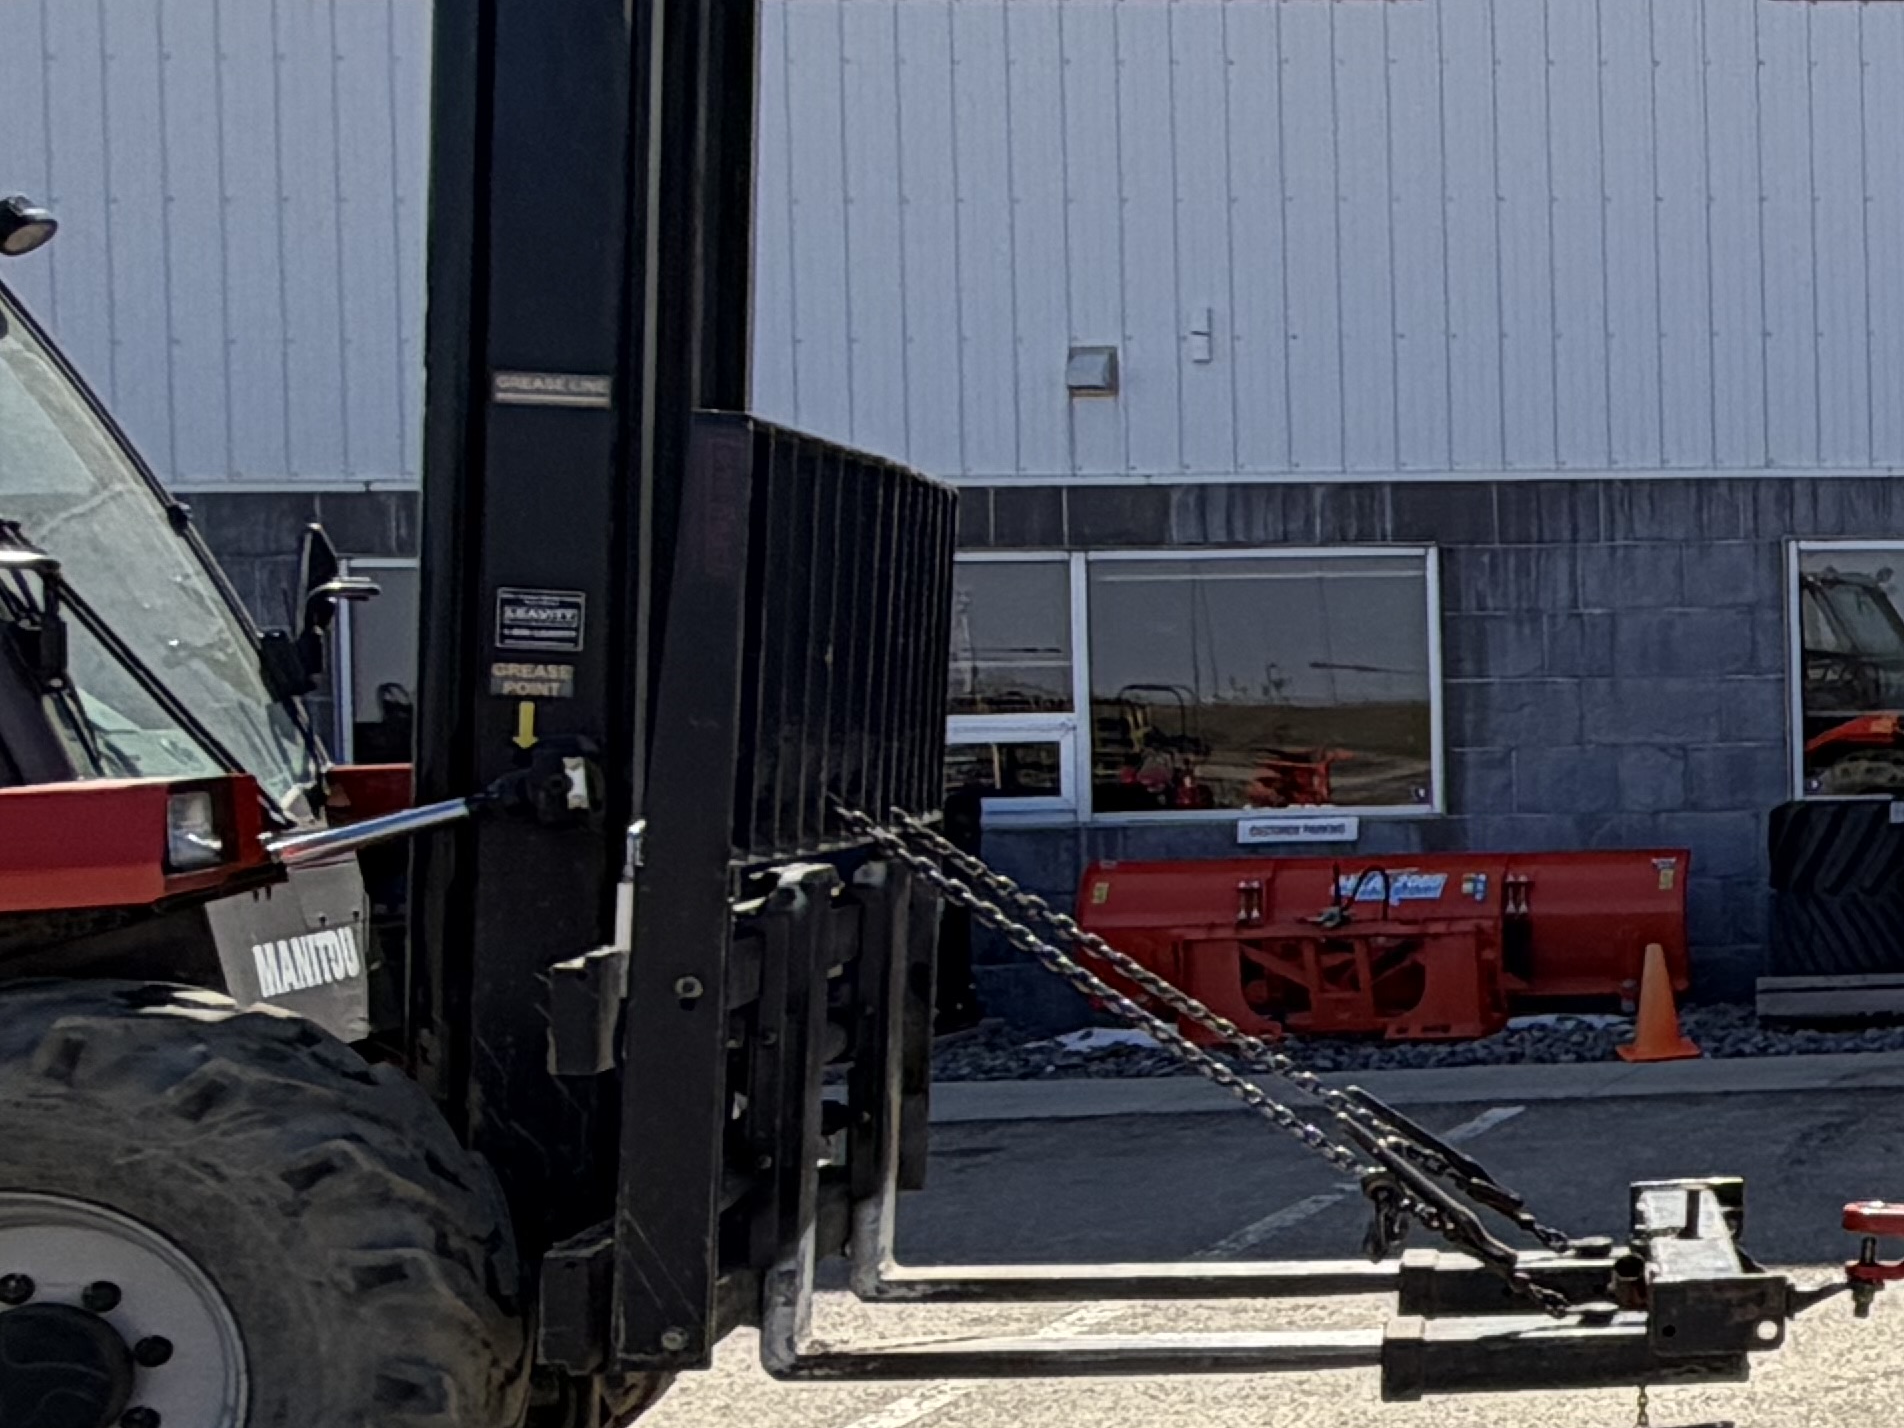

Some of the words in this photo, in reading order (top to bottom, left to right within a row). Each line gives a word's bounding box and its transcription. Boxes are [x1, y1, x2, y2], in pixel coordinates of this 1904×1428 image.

[492, 663, 574, 680] GREASE
[502, 681, 561, 696] POINT
[252, 926, 361, 998] MANITOU
